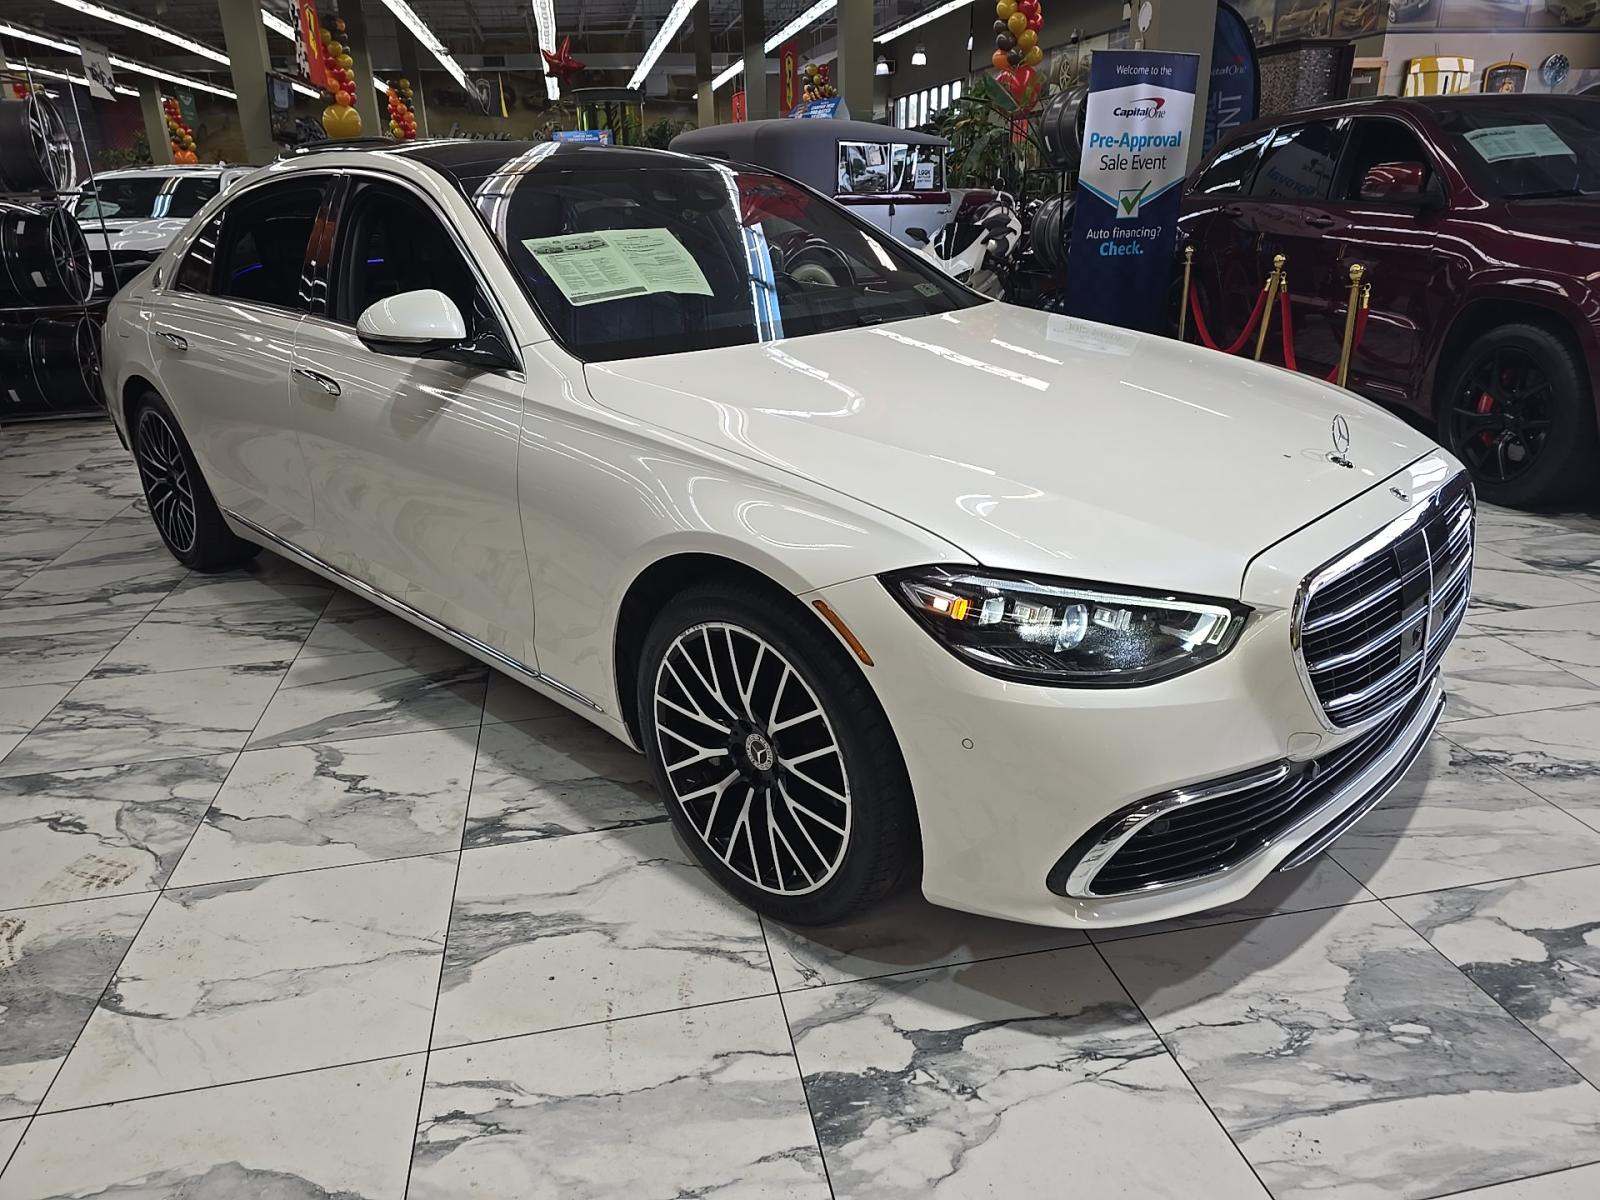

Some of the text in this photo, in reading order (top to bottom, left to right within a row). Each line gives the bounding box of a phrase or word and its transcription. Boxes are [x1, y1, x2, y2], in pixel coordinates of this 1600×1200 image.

[1116, 65, 1173, 76] Welcome to the
[1089, 131, 1182, 152] Pre-Approval
[1099, 154, 1167, 171] Sale Event
[1086, 226, 1162, 240] Auto financing?
[1099, 240, 1144, 256] Check.
